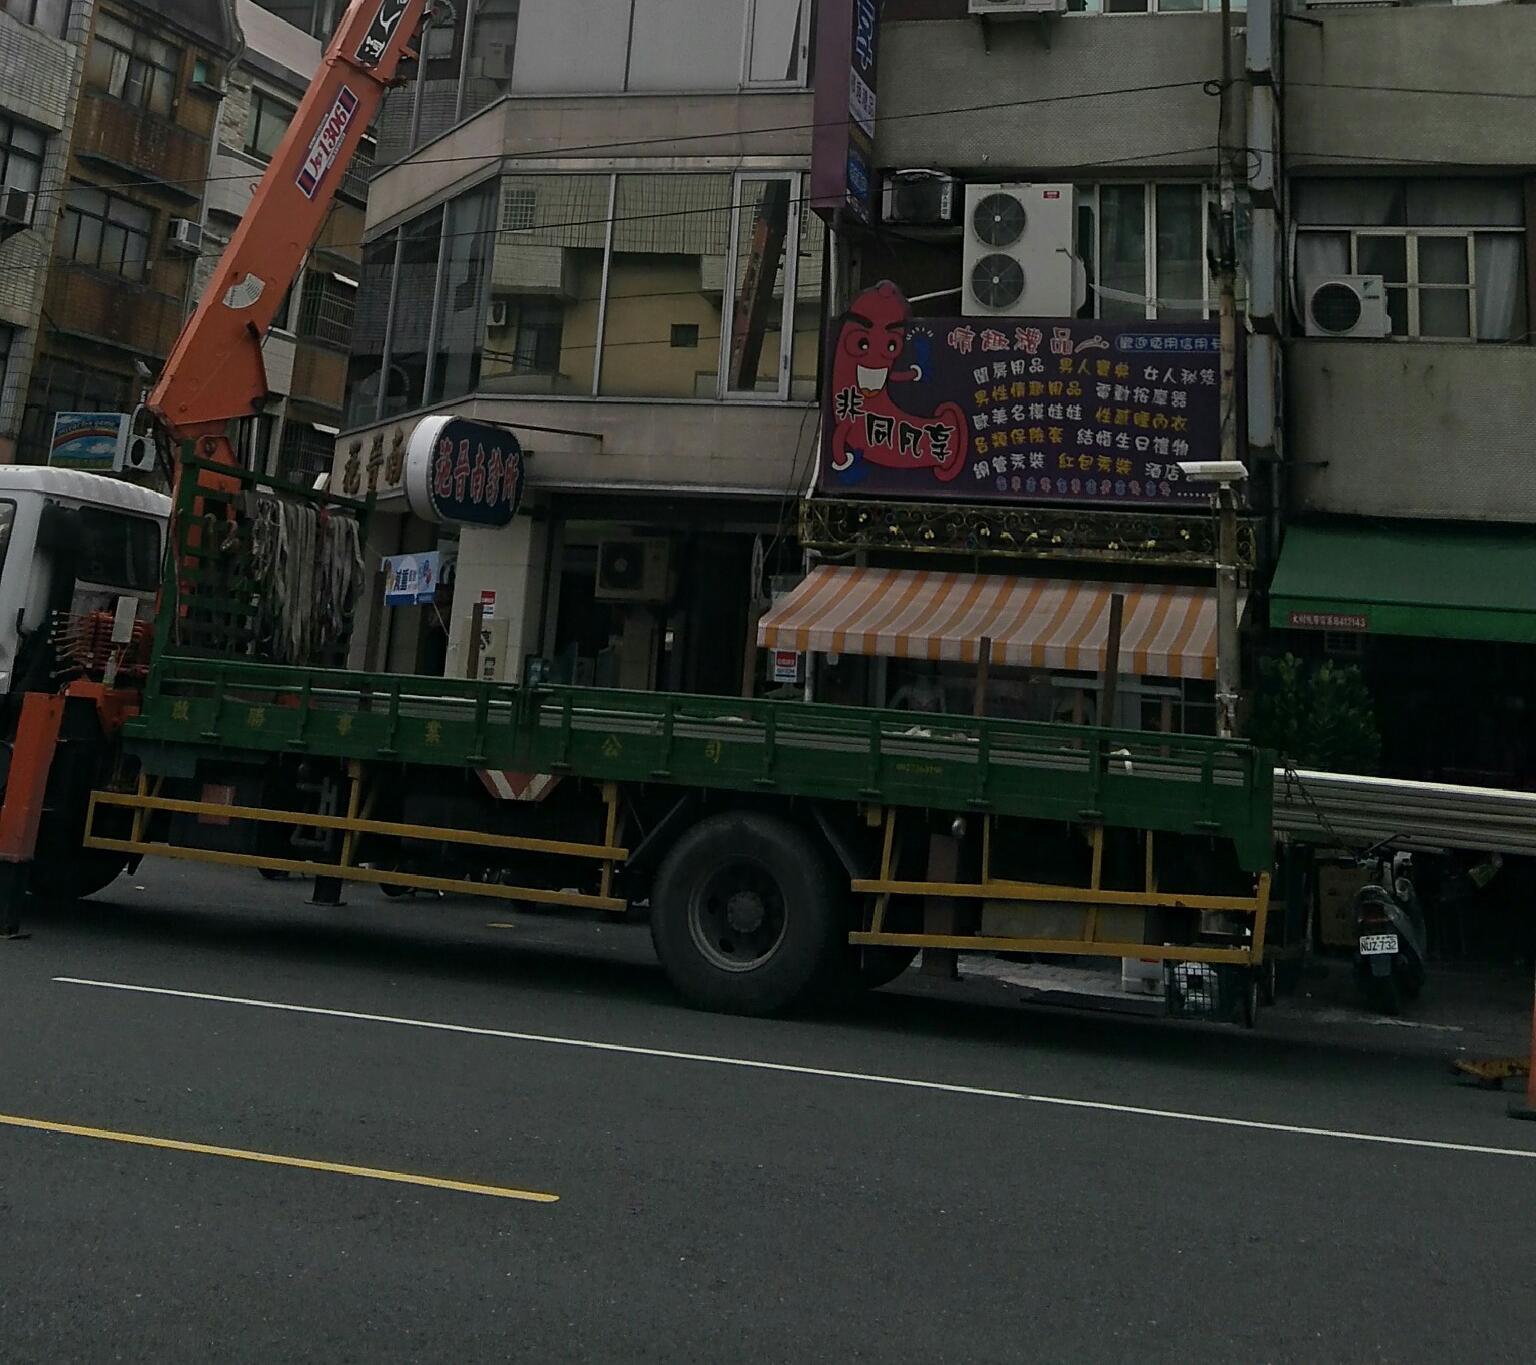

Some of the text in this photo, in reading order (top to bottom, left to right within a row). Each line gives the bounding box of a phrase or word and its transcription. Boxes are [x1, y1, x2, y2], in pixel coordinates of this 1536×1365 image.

[1058, 357, 1130, 380] 男人寶典
[974, 380, 1189, 410] 男性情趣用品 電動按摩器
[835, 384, 956, 463] 非同凡享
[972, 402, 1083, 431] 歐美名模娃娃
[974, 426, 1190, 458] 各類保險套 結婚生日禮物
[1144, 461, 1192, 483] 酒店
